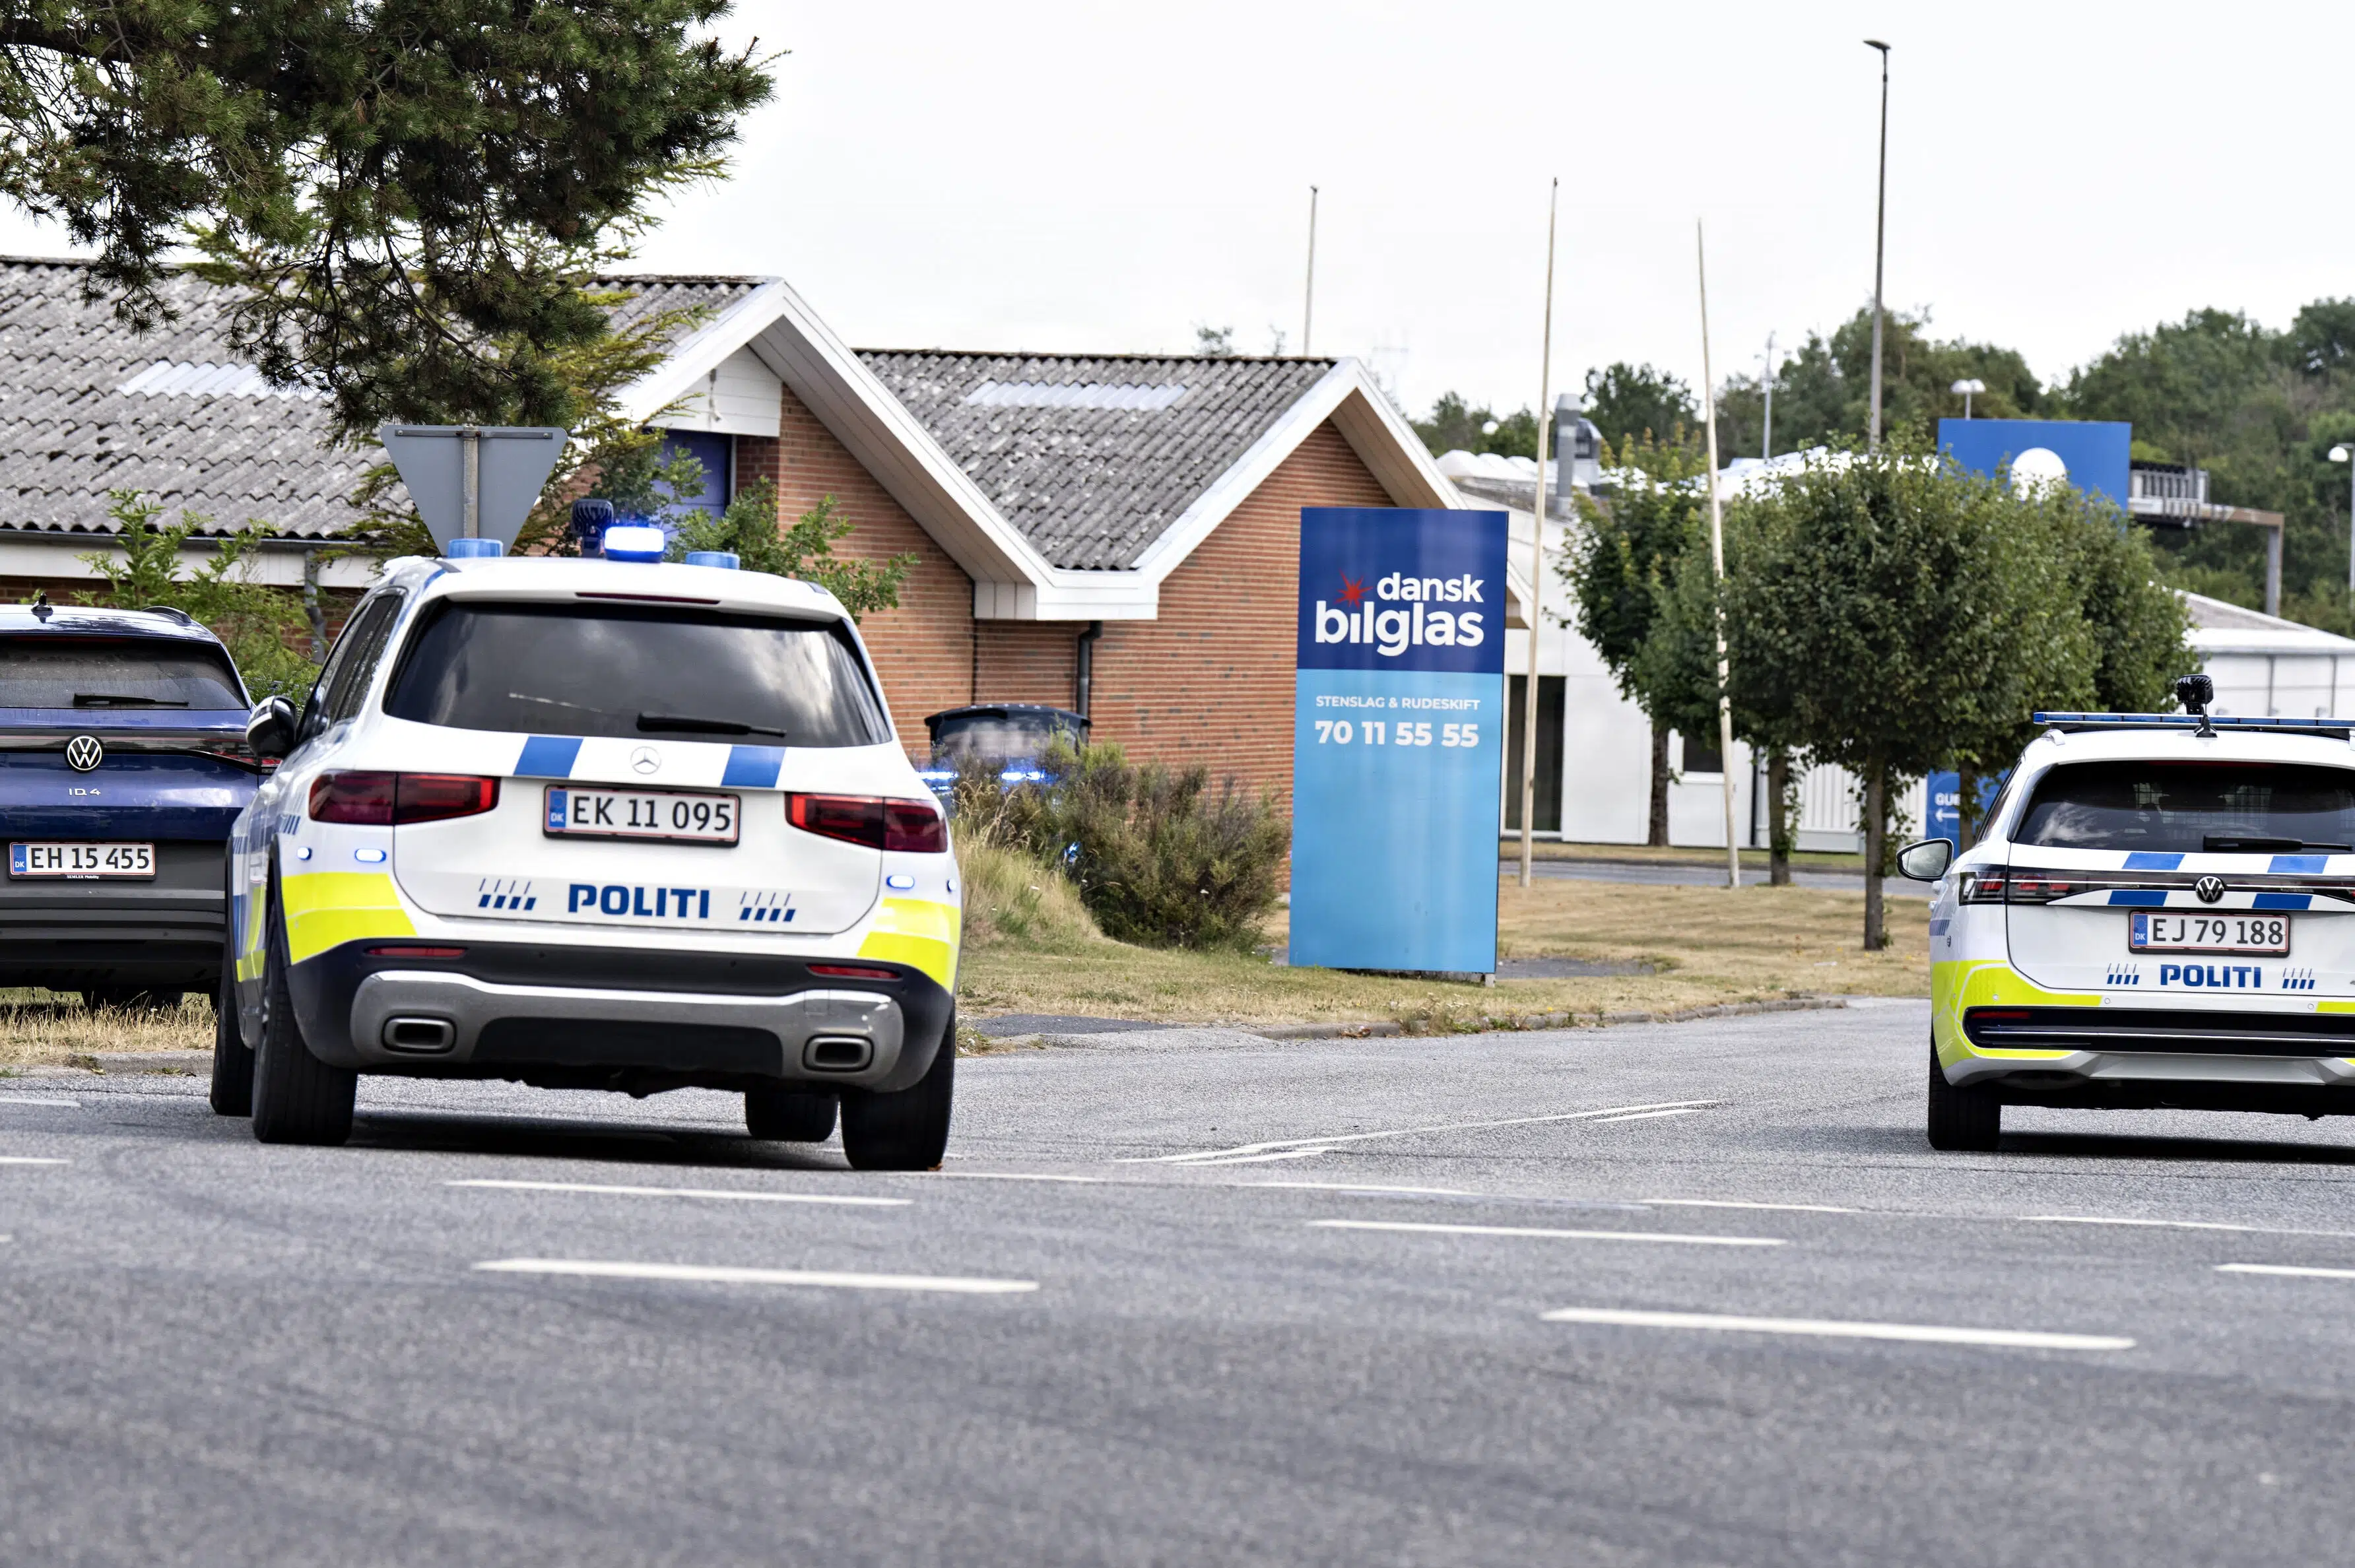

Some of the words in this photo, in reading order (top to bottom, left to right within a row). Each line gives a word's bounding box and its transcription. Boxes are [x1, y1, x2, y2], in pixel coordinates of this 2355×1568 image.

[1377, 572, 1484, 603] dansk
[1315, 600, 1484, 657] bilglas
[1315, 696, 1385, 708] STENSLAG
[1388, 697, 1398, 709] &
[1401, 698, 1481, 711] RUDESKIFT
[1315, 720, 1353, 744] 70
[1361, 721, 1386, 745] 11
[1395, 721, 1433, 746] 55
[1441, 723, 1480, 748] 55
[551, 812, 564, 824] DK
[572, 796, 614, 826] EK
[627, 798, 659, 829] 11
[672, 800, 731, 832] 095
[31, 847, 62, 868] EH
[71, 847, 98, 869] 15
[106, 848, 150, 870] 455
[568, 883, 710, 919] POLITI
[2135, 932, 2146, 941] DK
[2152, 918, 2186, 942] EJ
[2195, 919, 2226, 944] 79
[2236, 921, 2284, 945] 188
[2160, 964, 2262, 989] POLITI
